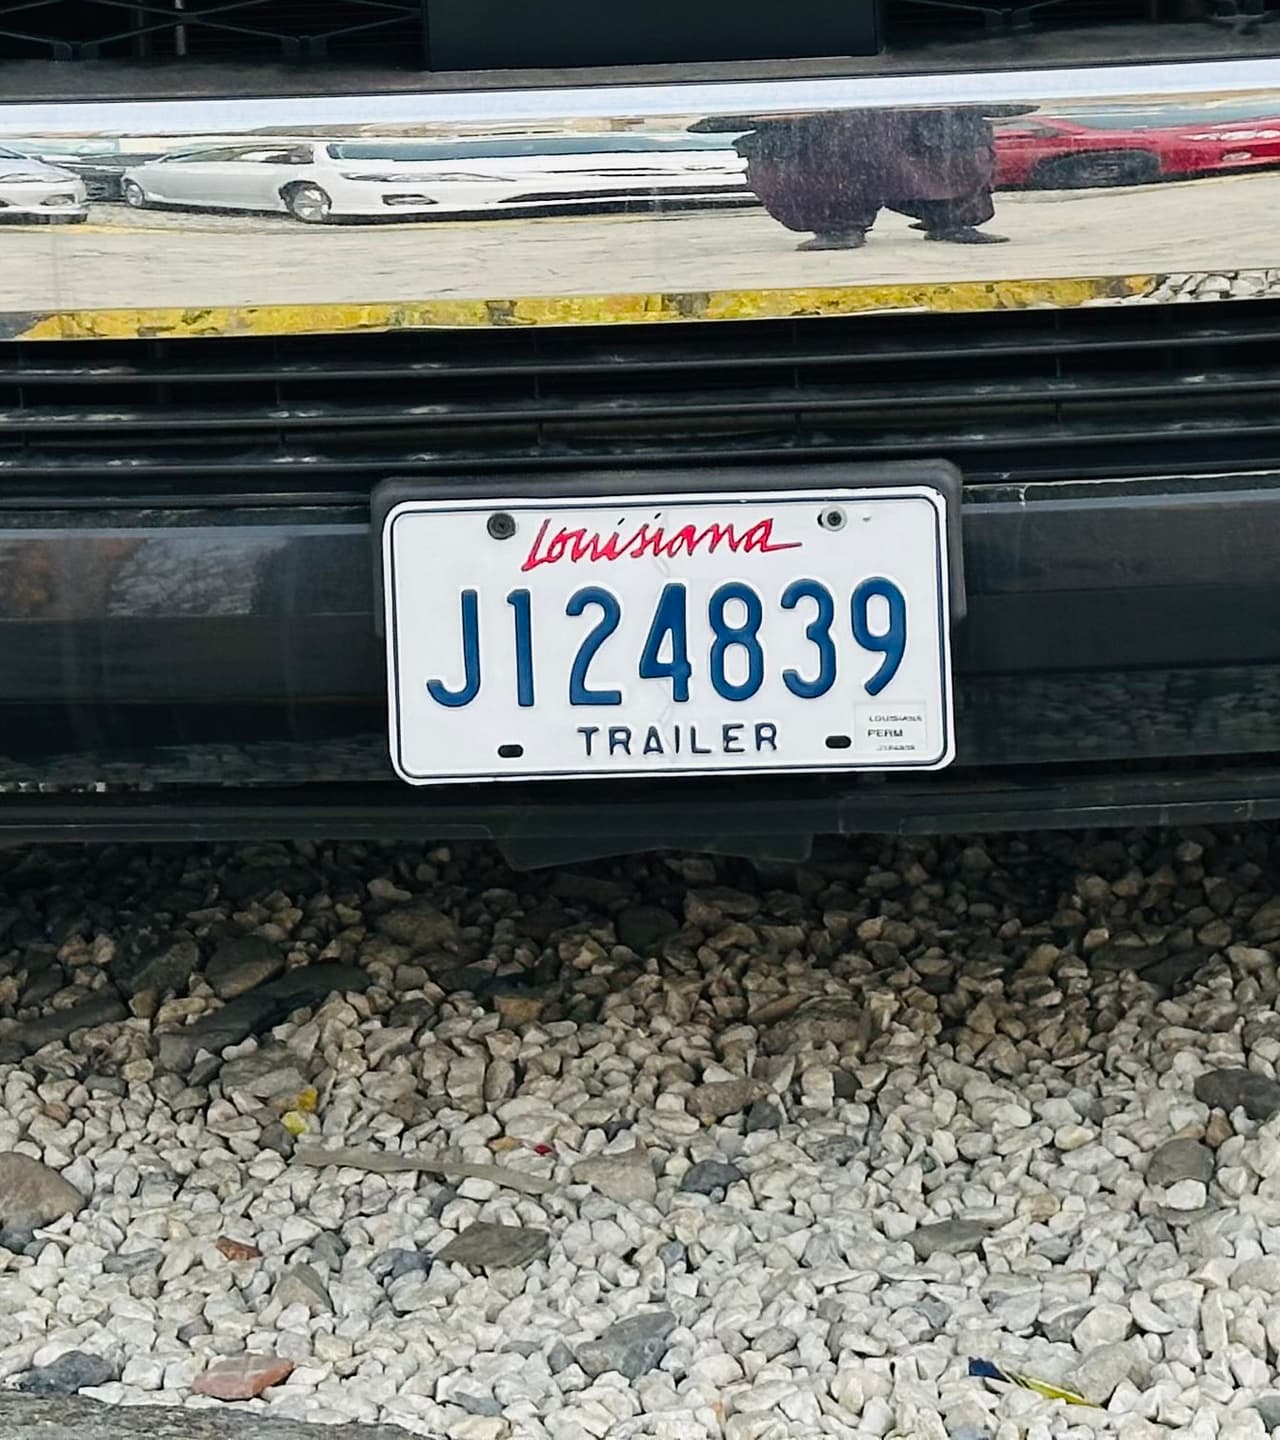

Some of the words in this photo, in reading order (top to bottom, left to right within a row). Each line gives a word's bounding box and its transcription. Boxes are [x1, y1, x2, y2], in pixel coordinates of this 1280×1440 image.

[520, 514, 803, 572] Louisiana
[425, 575, 908, 709] J124839
[576, 721, 779, 756] TRAILER
